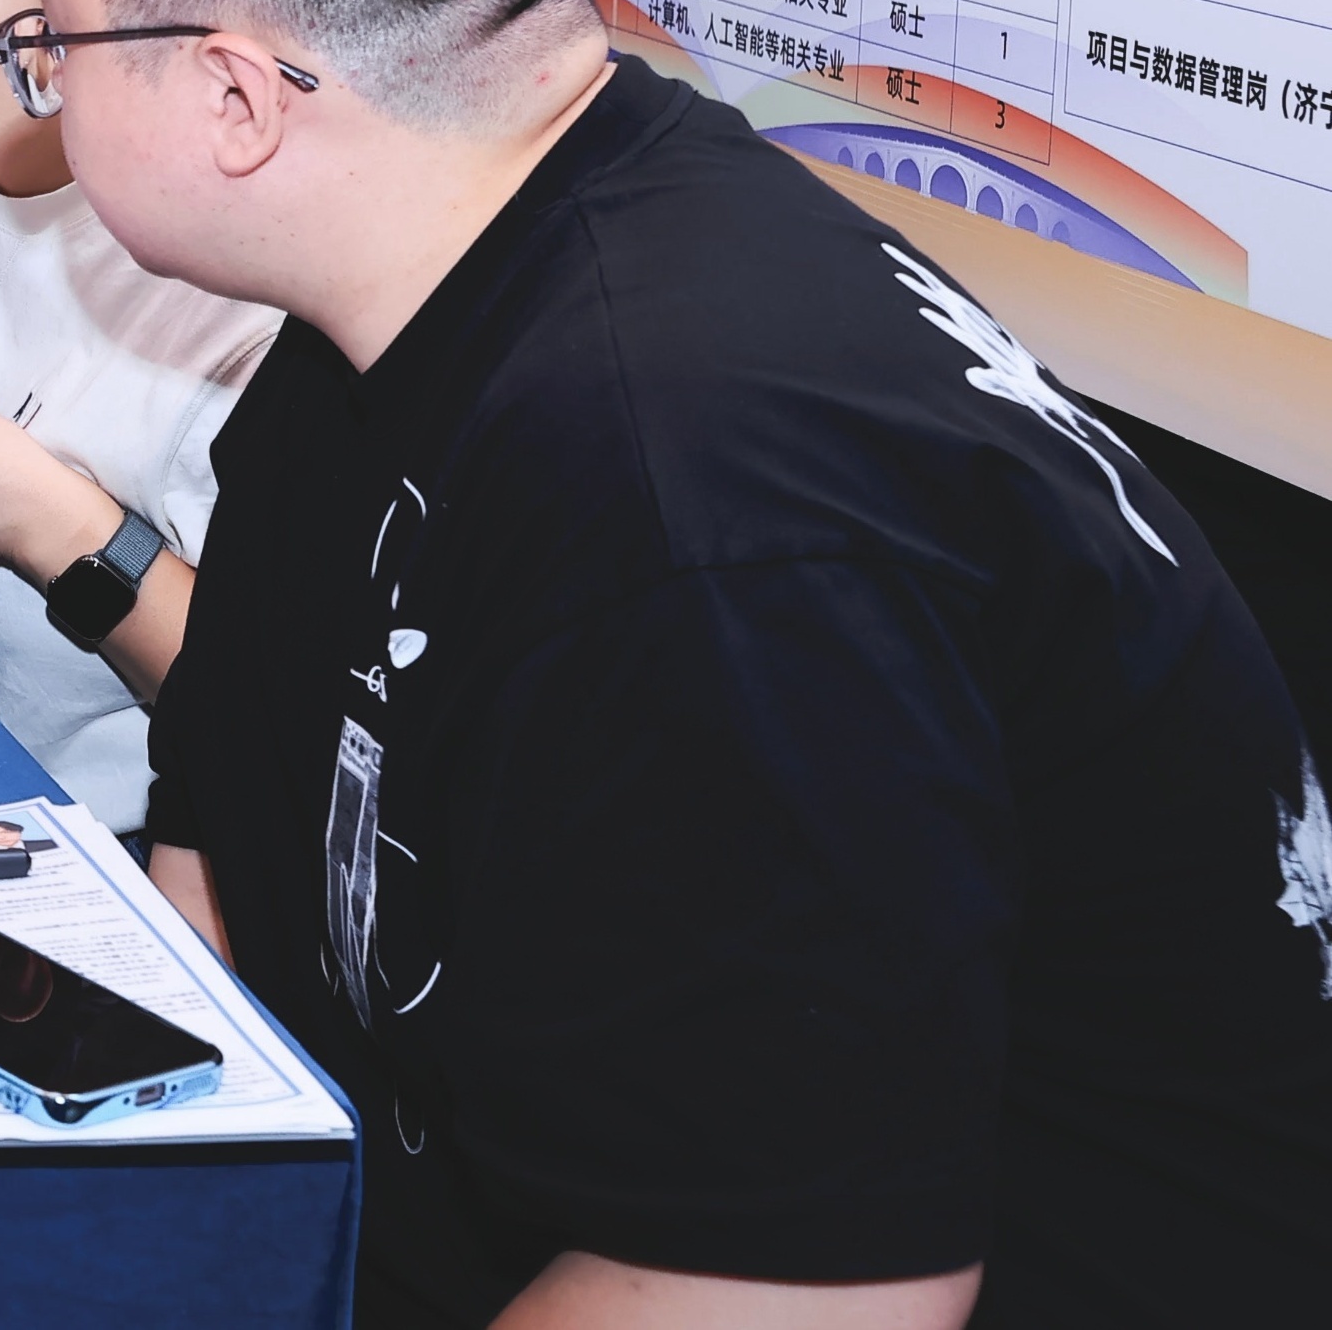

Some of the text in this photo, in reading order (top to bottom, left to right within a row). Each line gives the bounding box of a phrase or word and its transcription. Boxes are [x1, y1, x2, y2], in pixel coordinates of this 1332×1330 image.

[888, 0, 926, 39] 硕士
[1000, 31, 1009, 60] 1
[885, 66, 922, 105] 硕士
[994, 99, 1006, 129] 3
